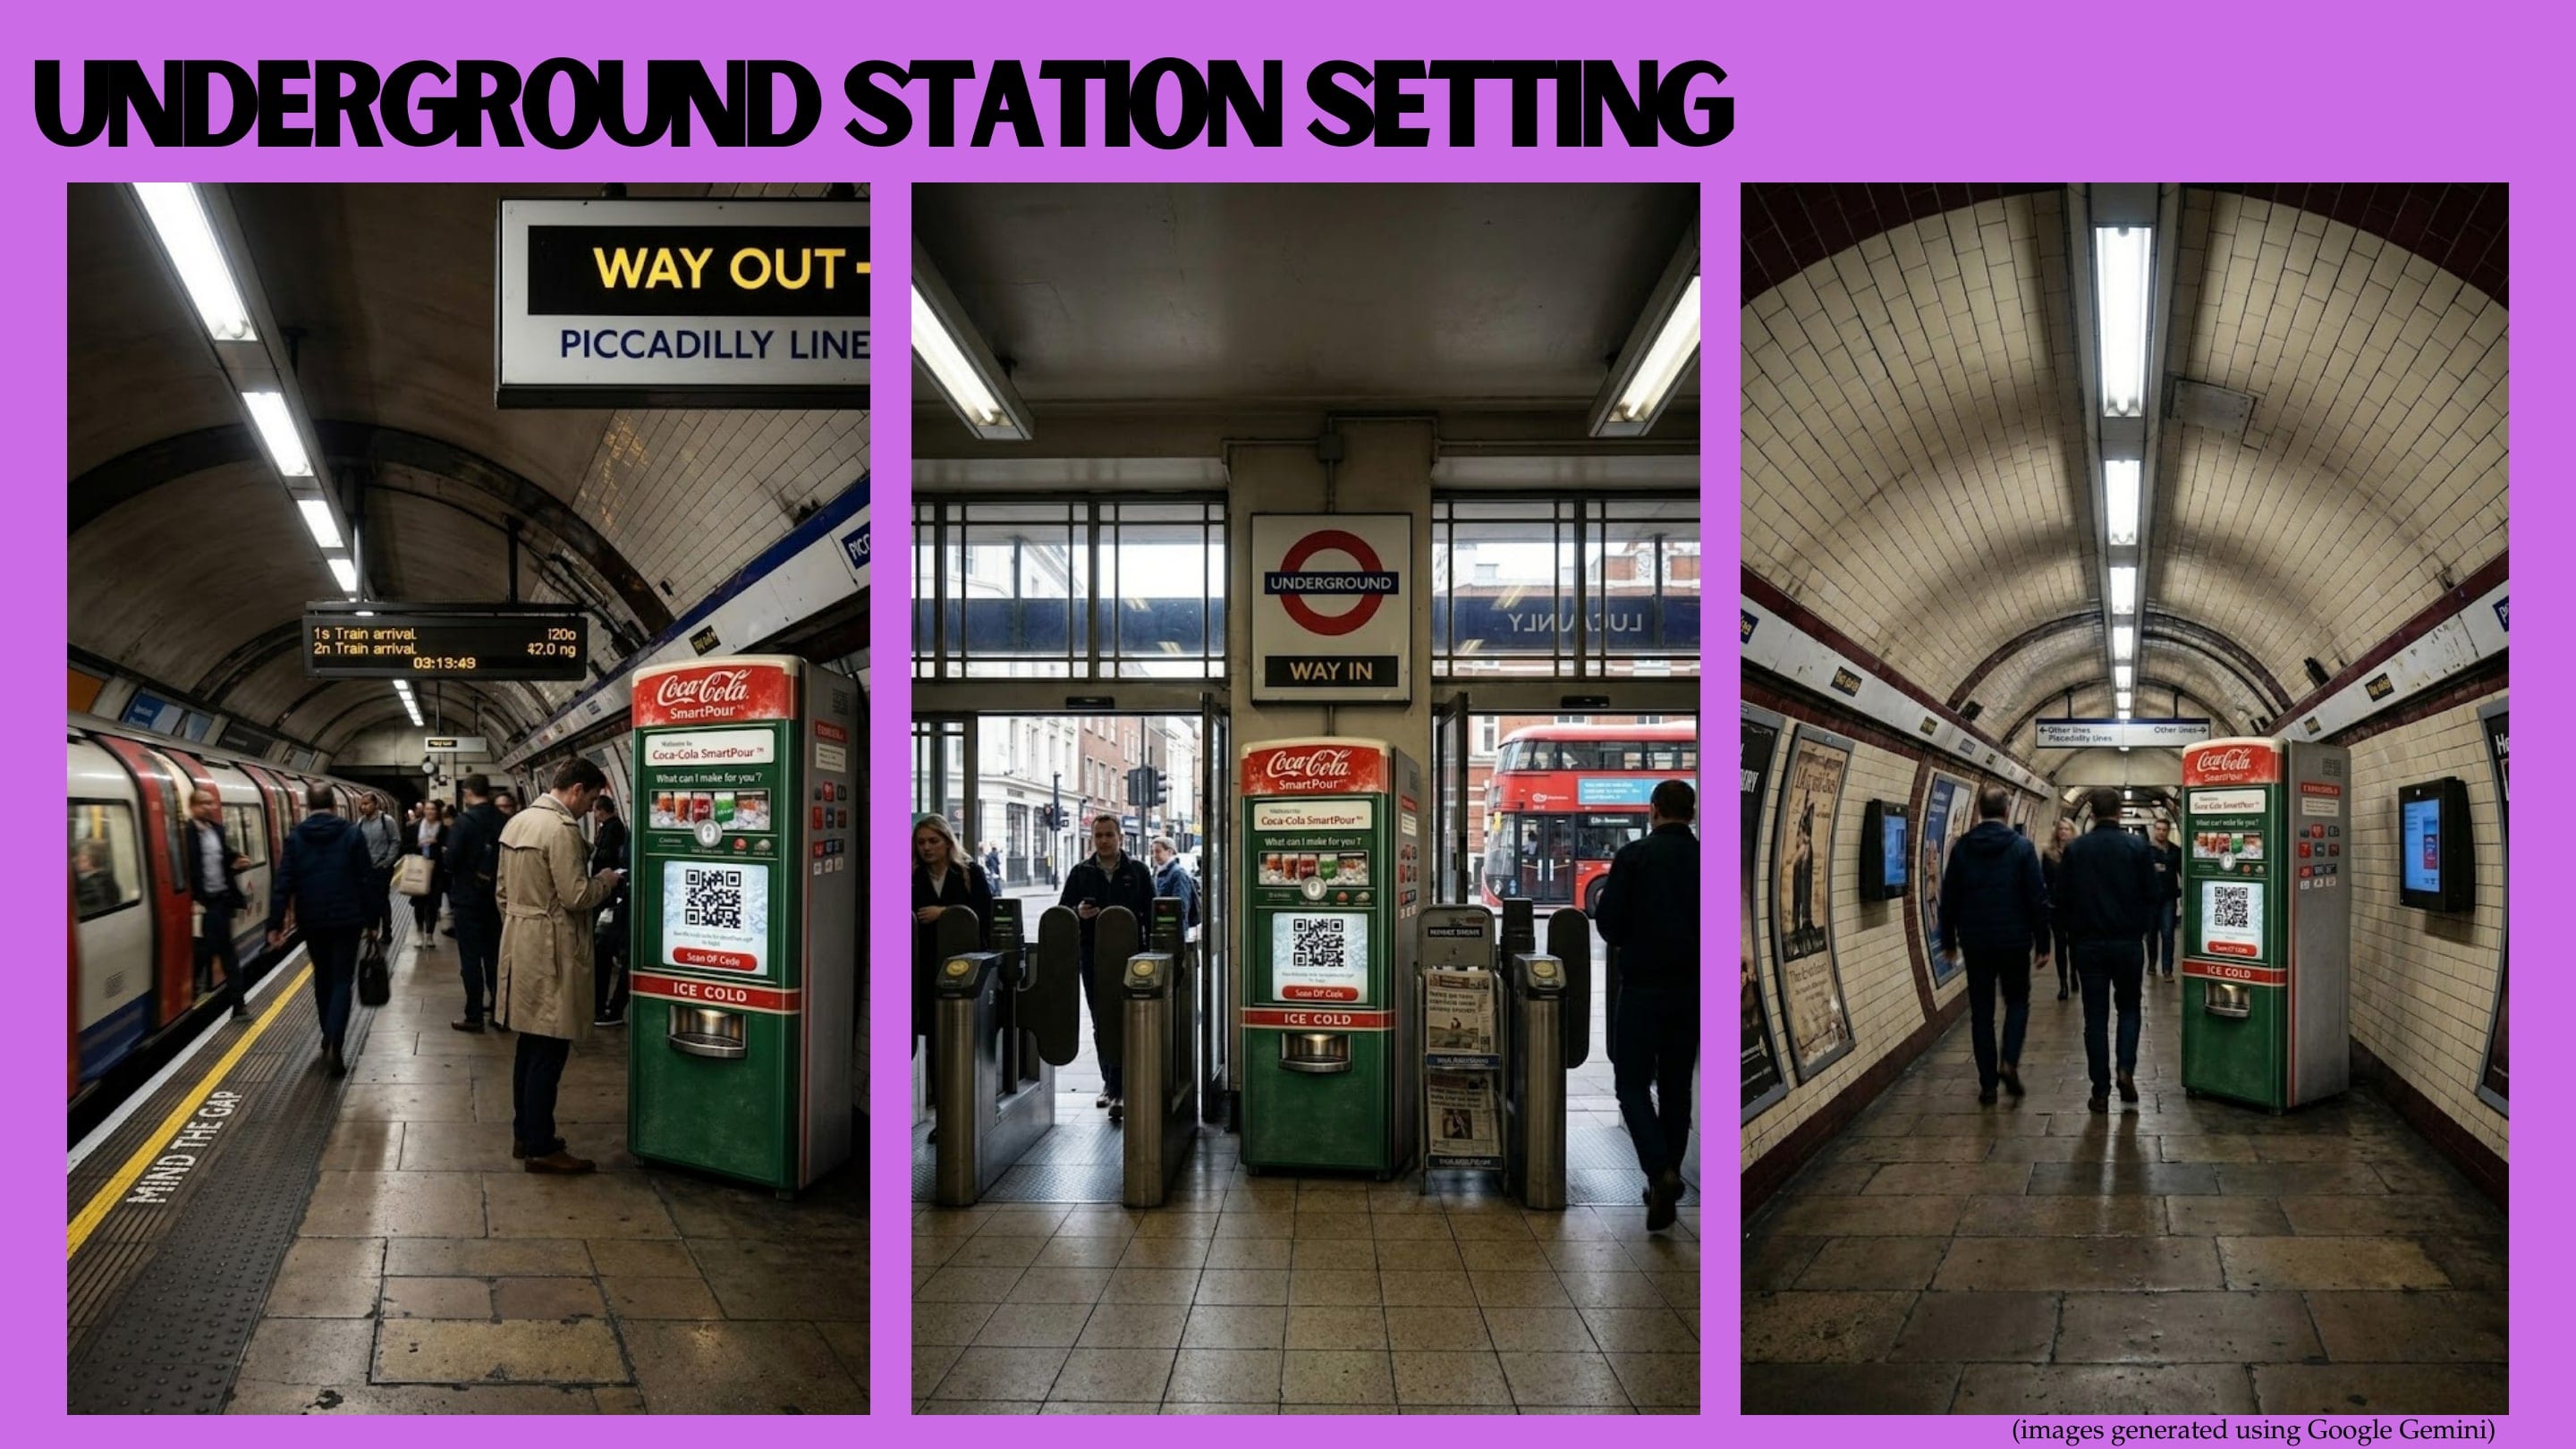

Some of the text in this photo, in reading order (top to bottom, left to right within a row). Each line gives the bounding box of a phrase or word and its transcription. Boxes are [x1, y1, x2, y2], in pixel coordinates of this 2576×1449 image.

[594, 248, 845, 290] WAY OUT
[562, 329, 869, 360] PICCADILLY LINE
[1271, 577, 1392, 589] UNDERGROUND
[314, 628, 330, 640] 1s
[335, 628, 369, 640] Train
[314, 642, 331, 654] 2n
[335, 642, 369, 654] Train
[1290, 662, 1373, 680] WAY IN
[670, 705, 734, 720] SmartPour
[652, 750, 699, 759] Coca-Cola
[701, 748, 755, 758] SmartPour
[1279, 779, 1338, 790] SmartPour
[2207, 965, 2251, 979] ICE COLD
[674, 982, 747, 1003] ICE COLD
[1284, 1013, 1352, 1025] ICE COLD
[126, 1089, 243, 1203] MIND THE GAP
